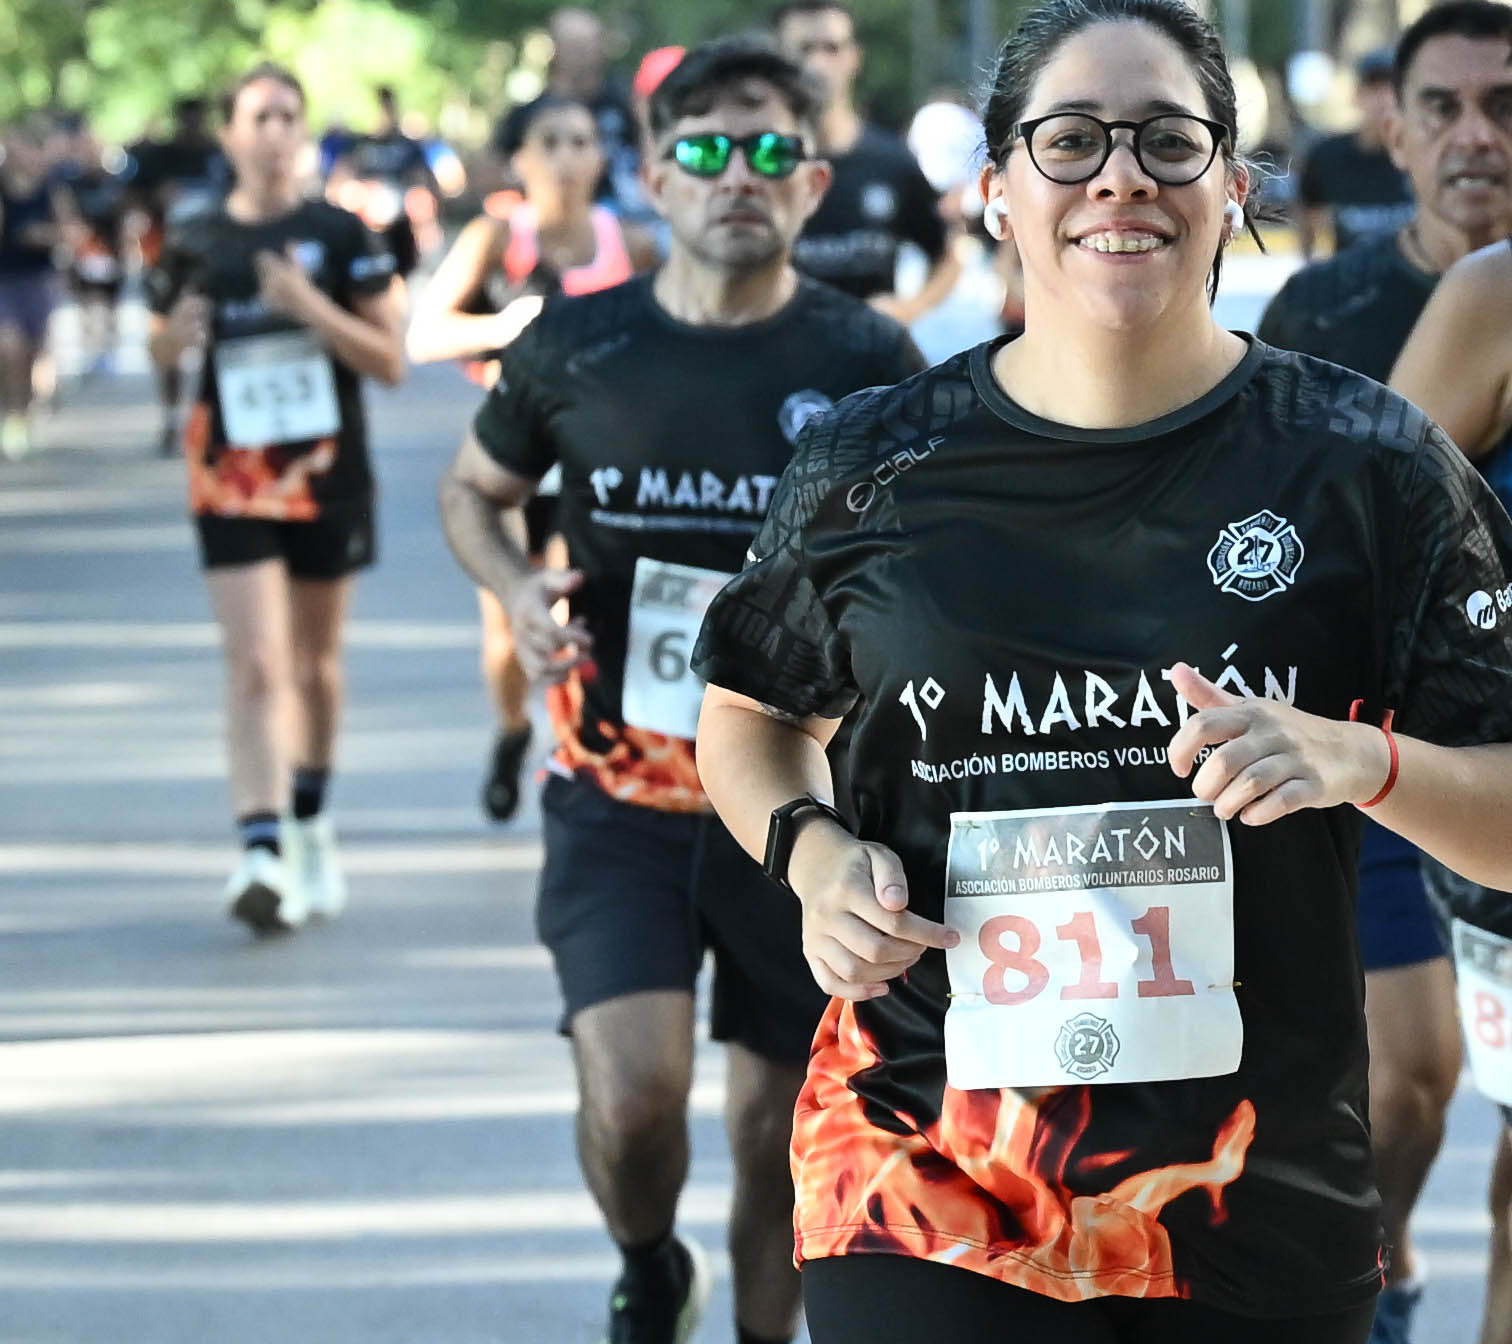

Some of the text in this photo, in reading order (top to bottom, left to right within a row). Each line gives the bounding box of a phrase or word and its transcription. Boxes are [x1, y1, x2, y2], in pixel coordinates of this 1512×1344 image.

[637, 467, 778, 513] MARAT
[1237, 536, 1274, 566] 27
[650, 630, 689, 682] 6
[1001, 750, 1110, 773] BOMBEROS
[1013, 816, 1186, 869] MARATÓN
[955, 865, 1220, 895] ASOCIACIÓN BOMBEROS VOLUNTARIOS ROSARIO
[978, 906, 1196, 1006] 811
[1074, 1032, 1100, 1056] 27
